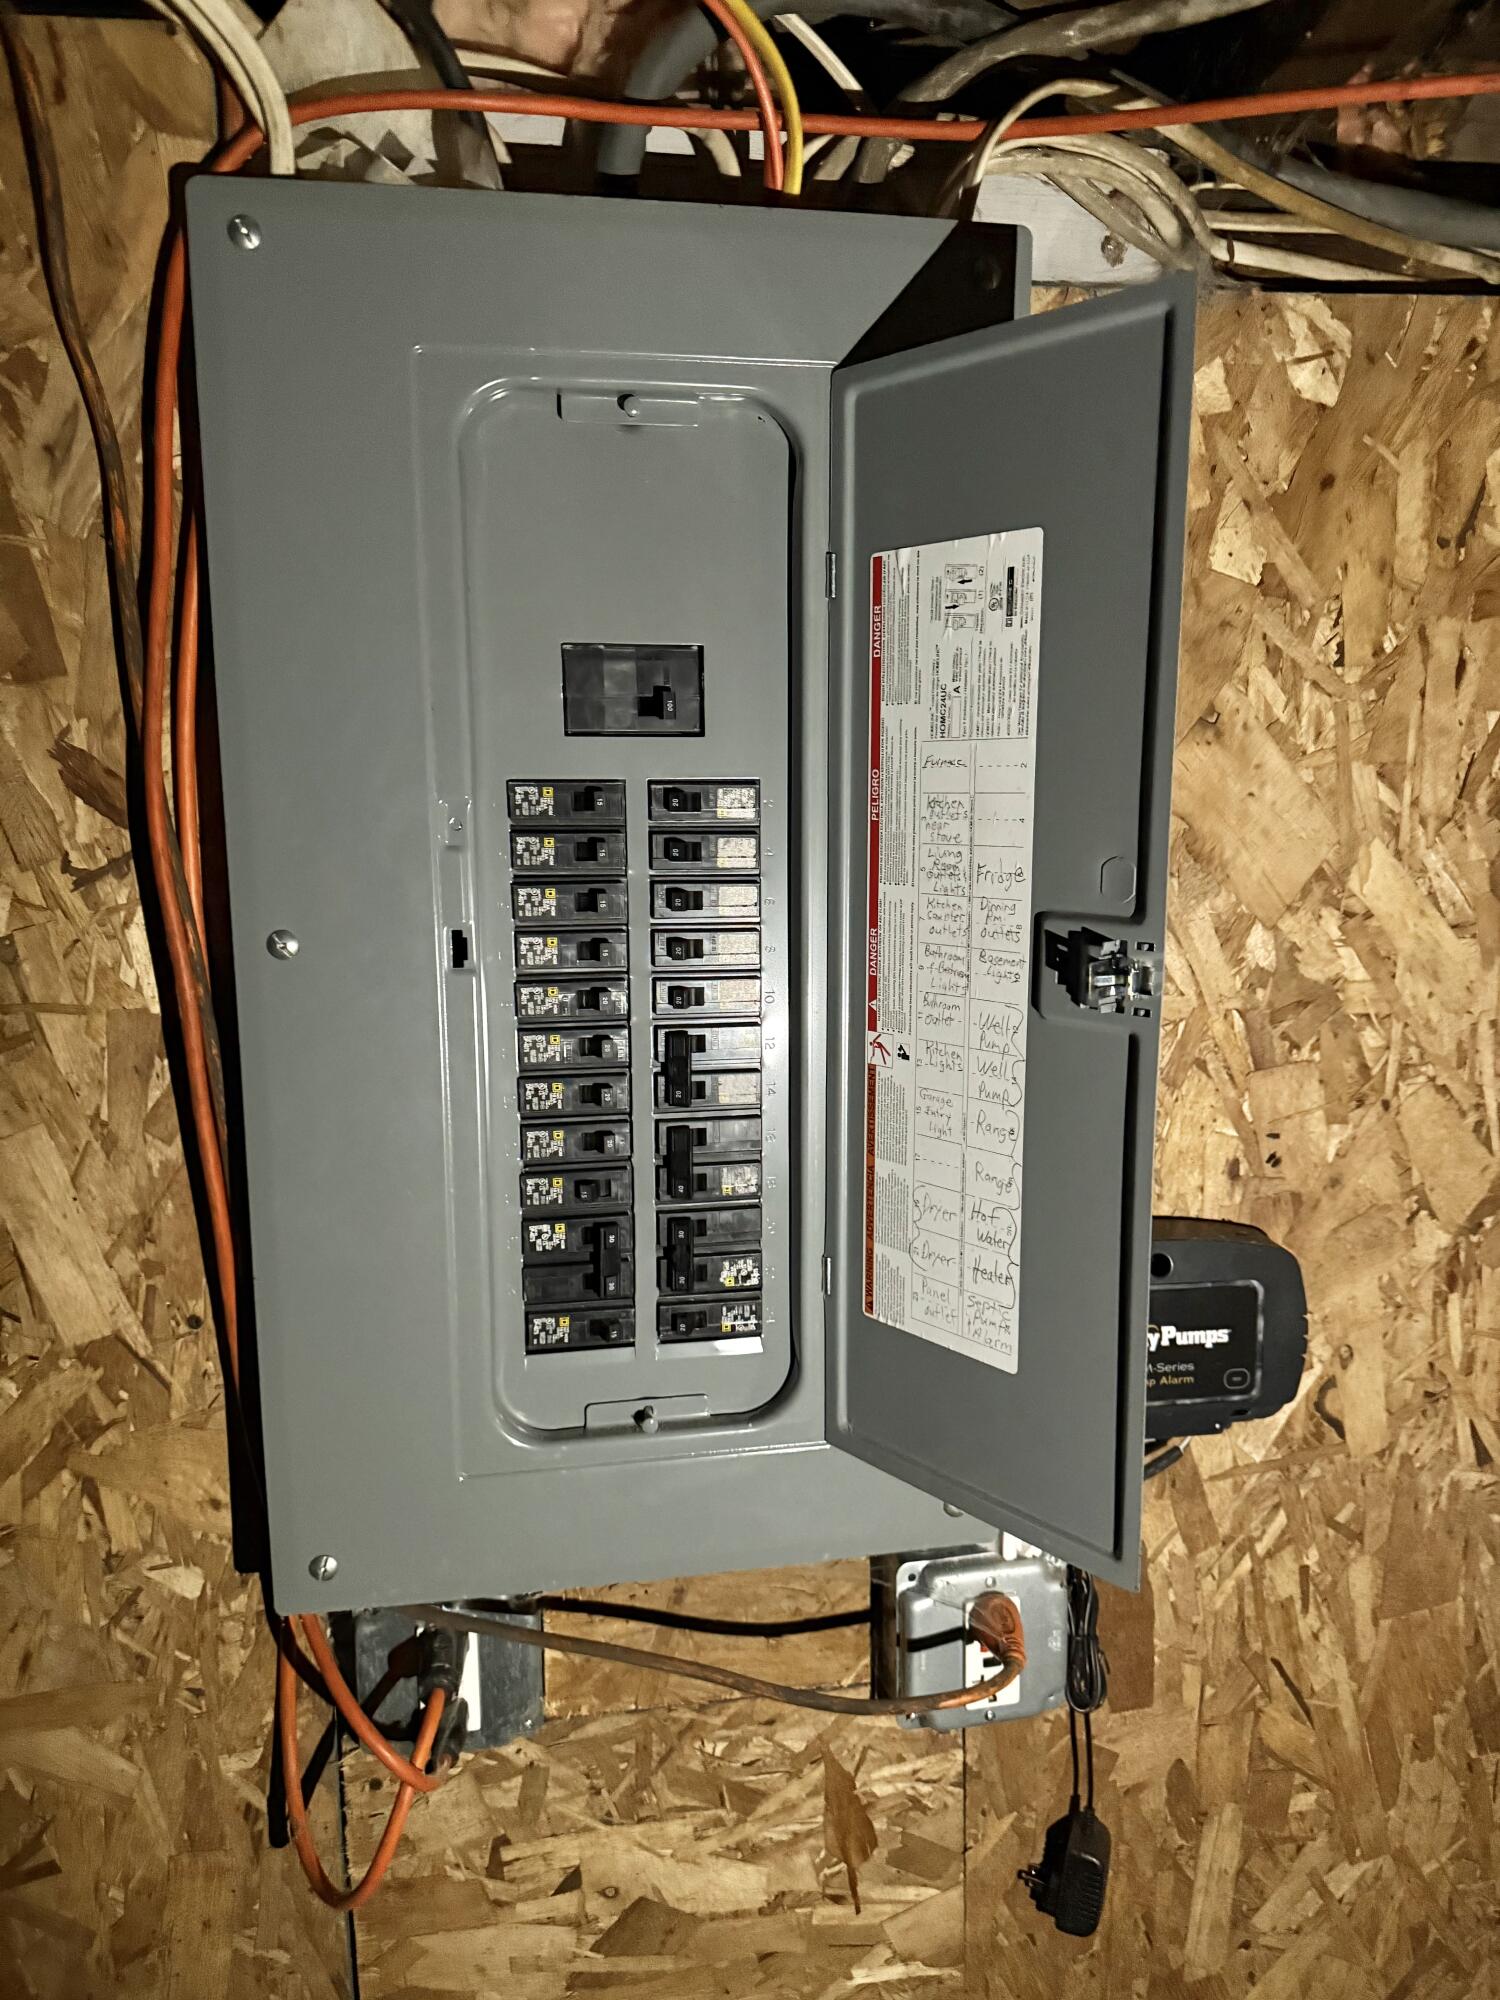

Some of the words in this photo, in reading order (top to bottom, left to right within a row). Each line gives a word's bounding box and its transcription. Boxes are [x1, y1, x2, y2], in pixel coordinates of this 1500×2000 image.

[872, 605, 882, 658] DANGER
[953, 684, 961, 694] A
[666, 700, 674, 712] 100
[939, 683, 947, 739] HOMC24UC
[596, 798, 604, 806] 15
[671, 798, 679, 807] 20
[871, 768, 880, 821] PELIGRO
[599, 849, 606, 857] 15
[672, 848, 679, 857] 20
[976, 857, 1026, 893] Fridge
[674, 898, 682, 907] 20
[675, 947, 682, 955] 20
[869, 927, 878, 976] DANGER
[978, 948, 1027, 969] Basement
[602, 996, 609, 1004] 20
[675, 996, 682, 1005] 20
[764, 990, 776, 1005] 10
[978, 1012, 1011, 1039] Well
[764, 1036, 776, 1051] 12
[976, 1055, 1010, 1082] Well
[675, 1090, 682, 1099] 20
[765, 1081, 777, 1097] 14
[978, 1080, 1013, 1111] Pump
[867, 1066, 876, 1156] AVERTISSEMENT
[976, 1109, 1017, 1144] Range
[606, 1139, 614, 1148] 20
[677, 1185, 685, 1193] 40
[975, 1160, 1014, 1196] Range
[866, 1165, 875, 1240] ADVERTENCIA
[922, 1191, 958, 1223] Dryer
[970, 1199, 1001, 1225] Hot
[608, 1234, 615, 1243] 30
[976, 1226, 1011, 1250] Water
[921, 1240, 957, 1268] Dryer
[865, 1248, 874, 1297] WARNING
[972, 1254, 1013, 1286] Heater
[921, 1278, 951, 1305] Panel
[1160, 1374, 1195, 1386] Alarm
